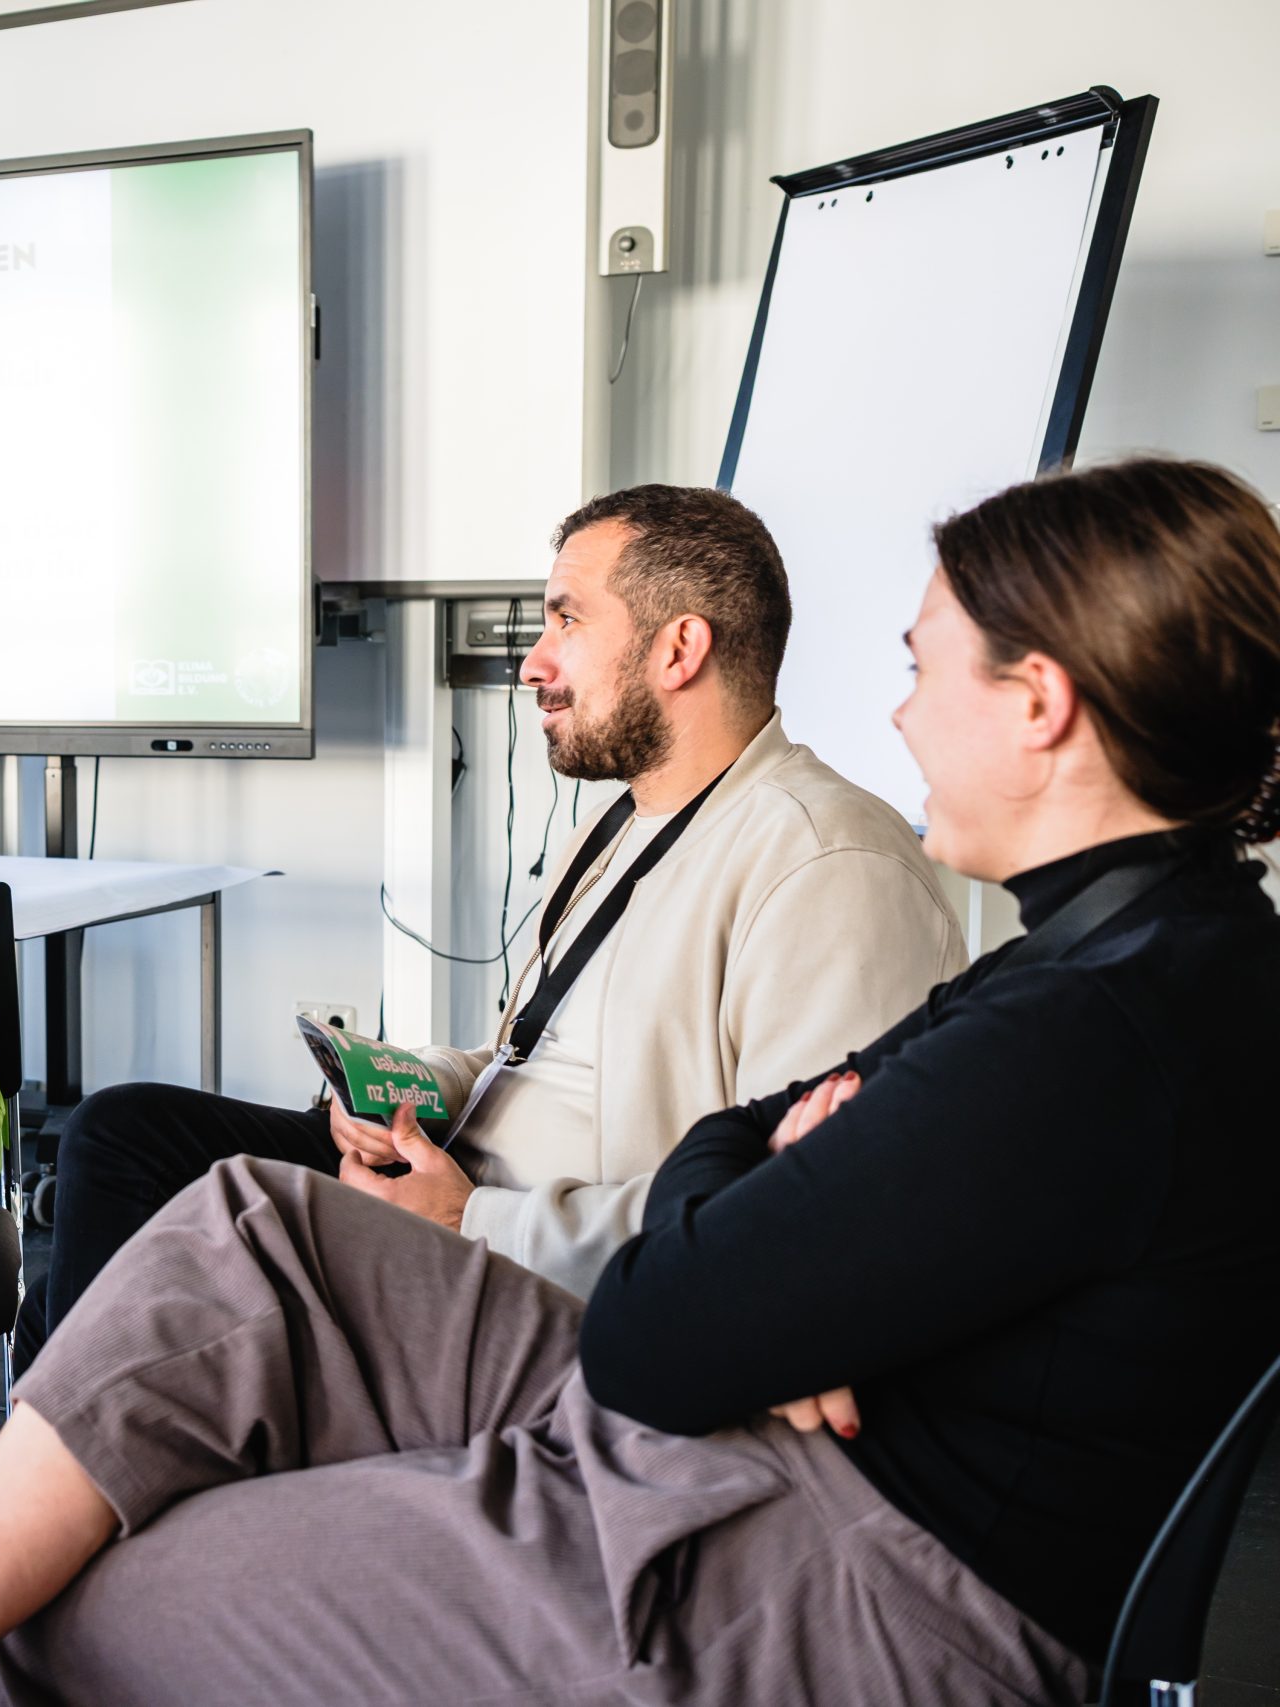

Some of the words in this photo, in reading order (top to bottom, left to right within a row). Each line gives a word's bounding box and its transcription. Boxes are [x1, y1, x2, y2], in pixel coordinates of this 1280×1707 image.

[370, 1055, 432, 1081] Morgen
[367, 1085, 385, 1101] zu
[386, 1081, 443, 1112] Zugang
